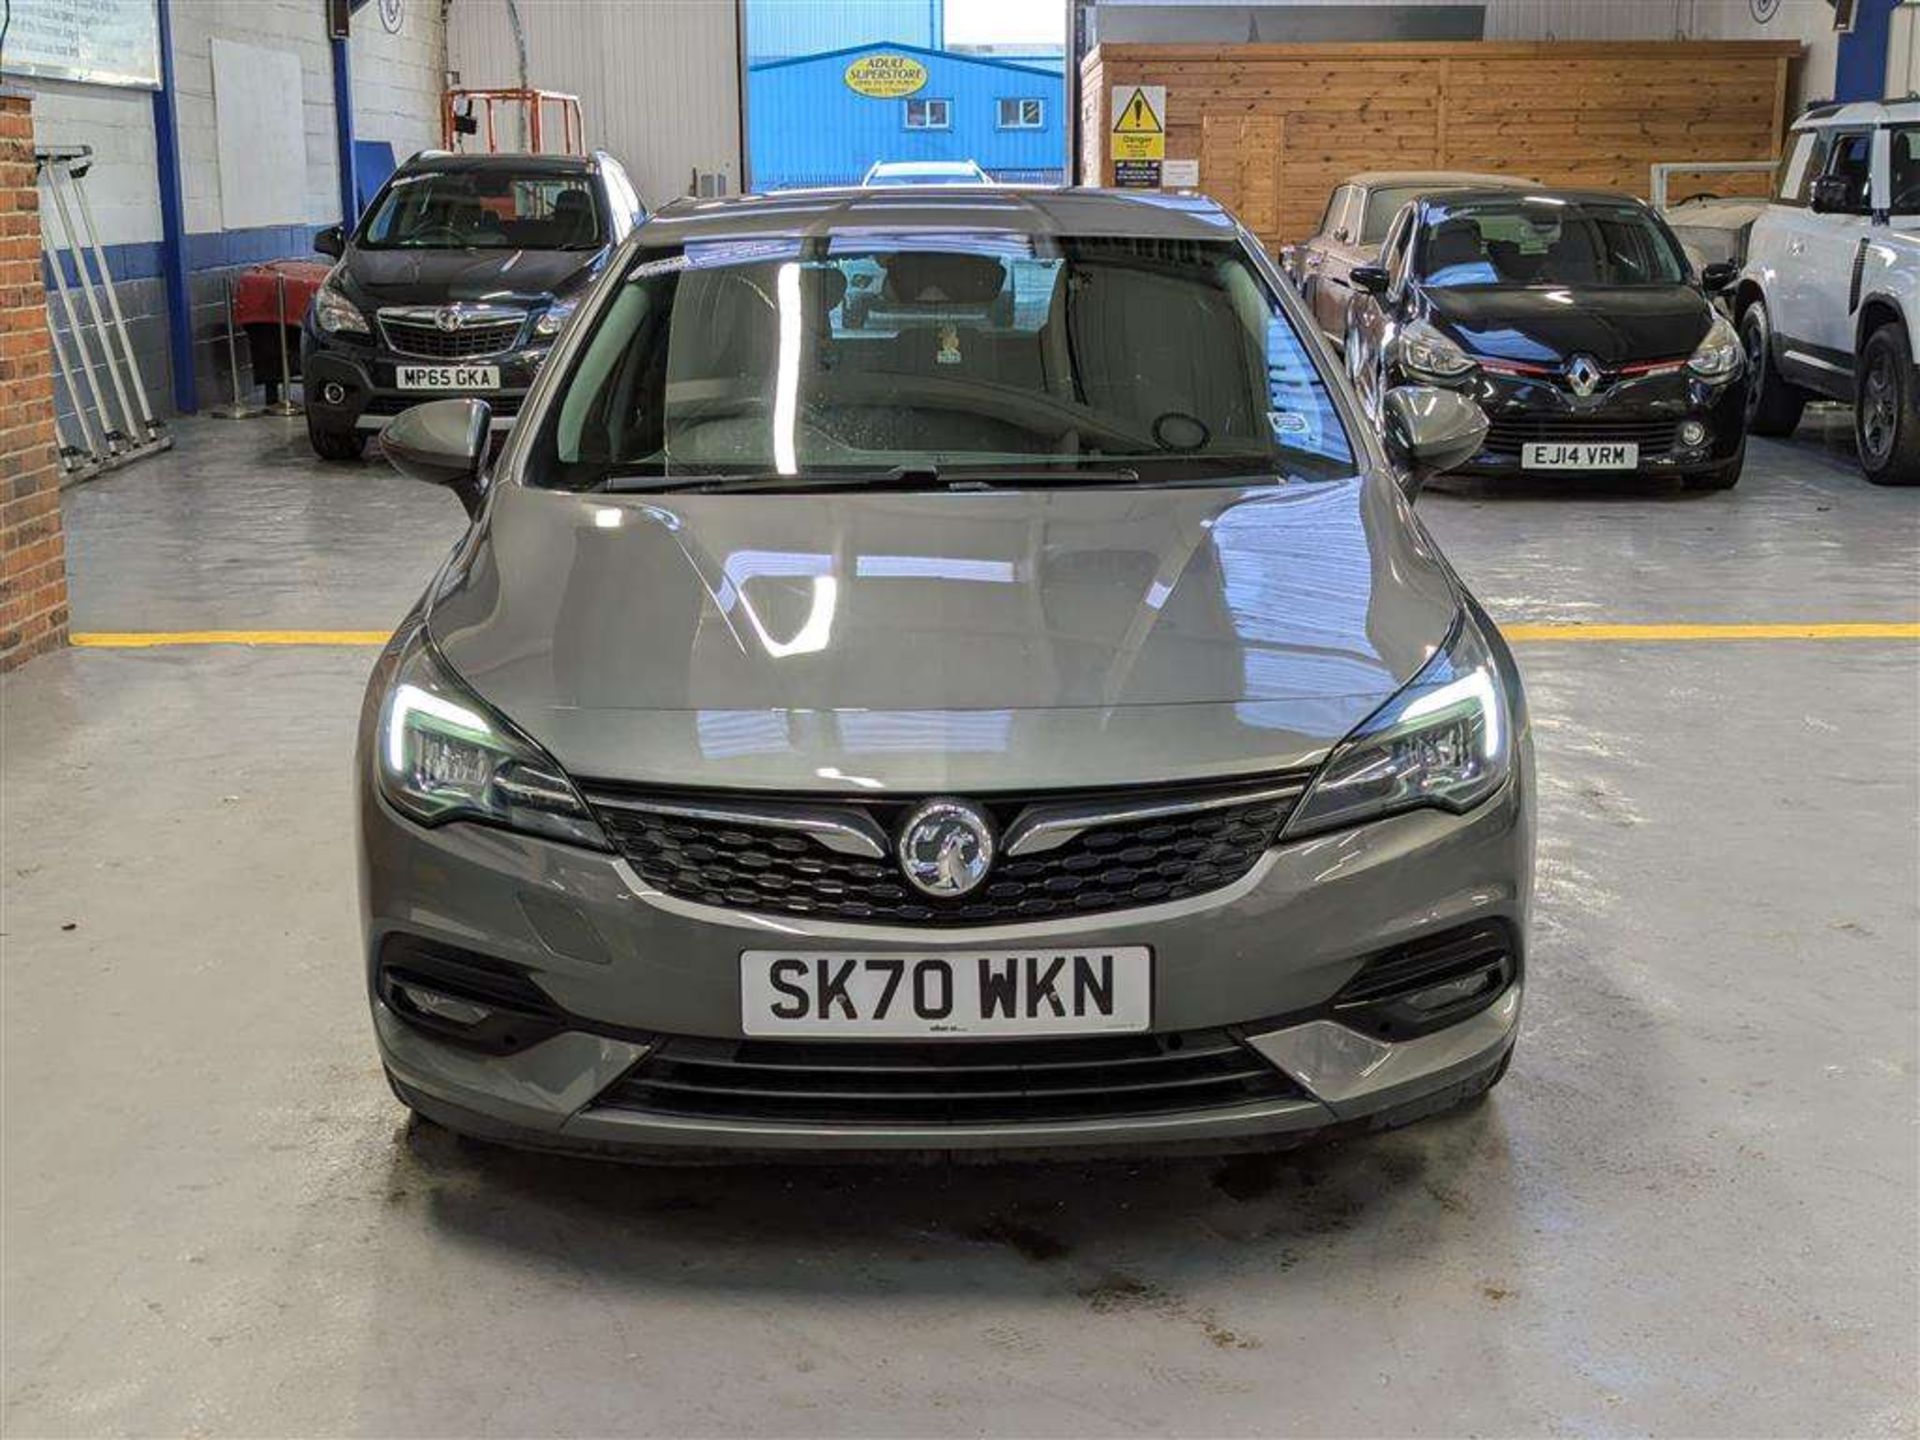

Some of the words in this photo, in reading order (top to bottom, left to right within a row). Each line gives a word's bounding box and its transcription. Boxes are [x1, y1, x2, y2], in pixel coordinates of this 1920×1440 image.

[869, 58, 904, 68] ADULT
[850, 69, 922, 80] SUPERSTORE
[404, 369, 451, 386] MP65
[456, 369, 490, 386] GKA
[1535, 446, 1579, 464] EJ14
[1587, 447, 1625, 464] VRM
[770, 959, 953, 1020] SK70
[978, 955, 1113, 1019] WKN
